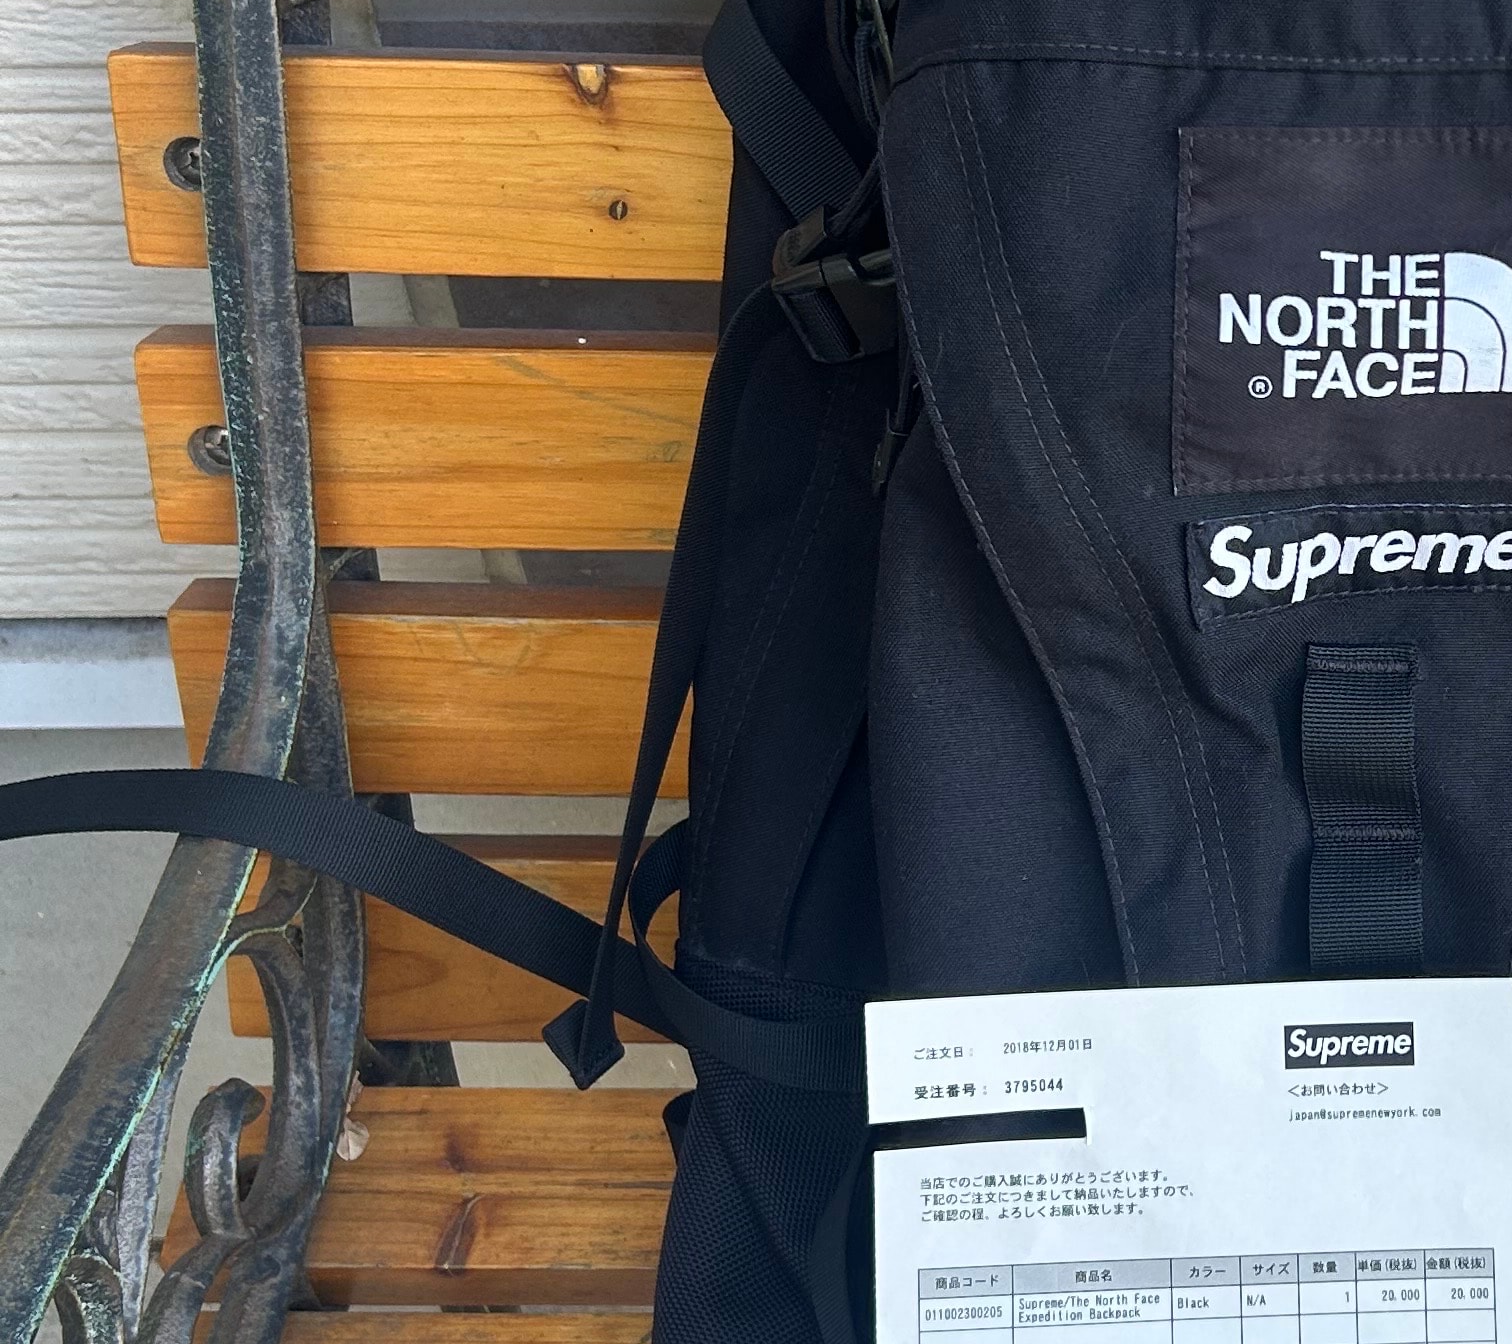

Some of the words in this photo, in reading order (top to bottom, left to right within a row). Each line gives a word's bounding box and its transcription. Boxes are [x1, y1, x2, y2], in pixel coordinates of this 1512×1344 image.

[1320, 251, 1440, 297] THE
[1219, 293, 1439, 350] NORTH
[1282, 349, 1439, 399] FACE
[1004, 1039, 1092, 1054] 2018年12月01日
[1288, 1028, 1412, 1064] Supreme
[1005, 1078, 1063, 1093] 3795044
[1189, 1266, 1226, 1279] カラー
[1252, 1262, 1290, 1276] サイズ
[1312, 1261, 1338, 1274] 数量
[935, 1273, 999, 1290] 商品コード
[1075, 1269, 1112, 1285] 商品名
[1246, 1294, 1267, 1306] N/A
[1381, 1289, 1420, 1302] 20,000
[1451, 1287, 1489, 1300] 20,000
[1019, 1295, 1089, 1311] Supreme/The
[1096, 1293, 1128, 1307] North
[1135, 1292, 1160, 1305] Face
[1177, 1297, 1210, 1309] Black
[925, 1306, 1002, 1321] 011002300205
[1019, 1308, 1083, 1324] Expedition
[1090, 1306, 1141, 1321] Backpack
